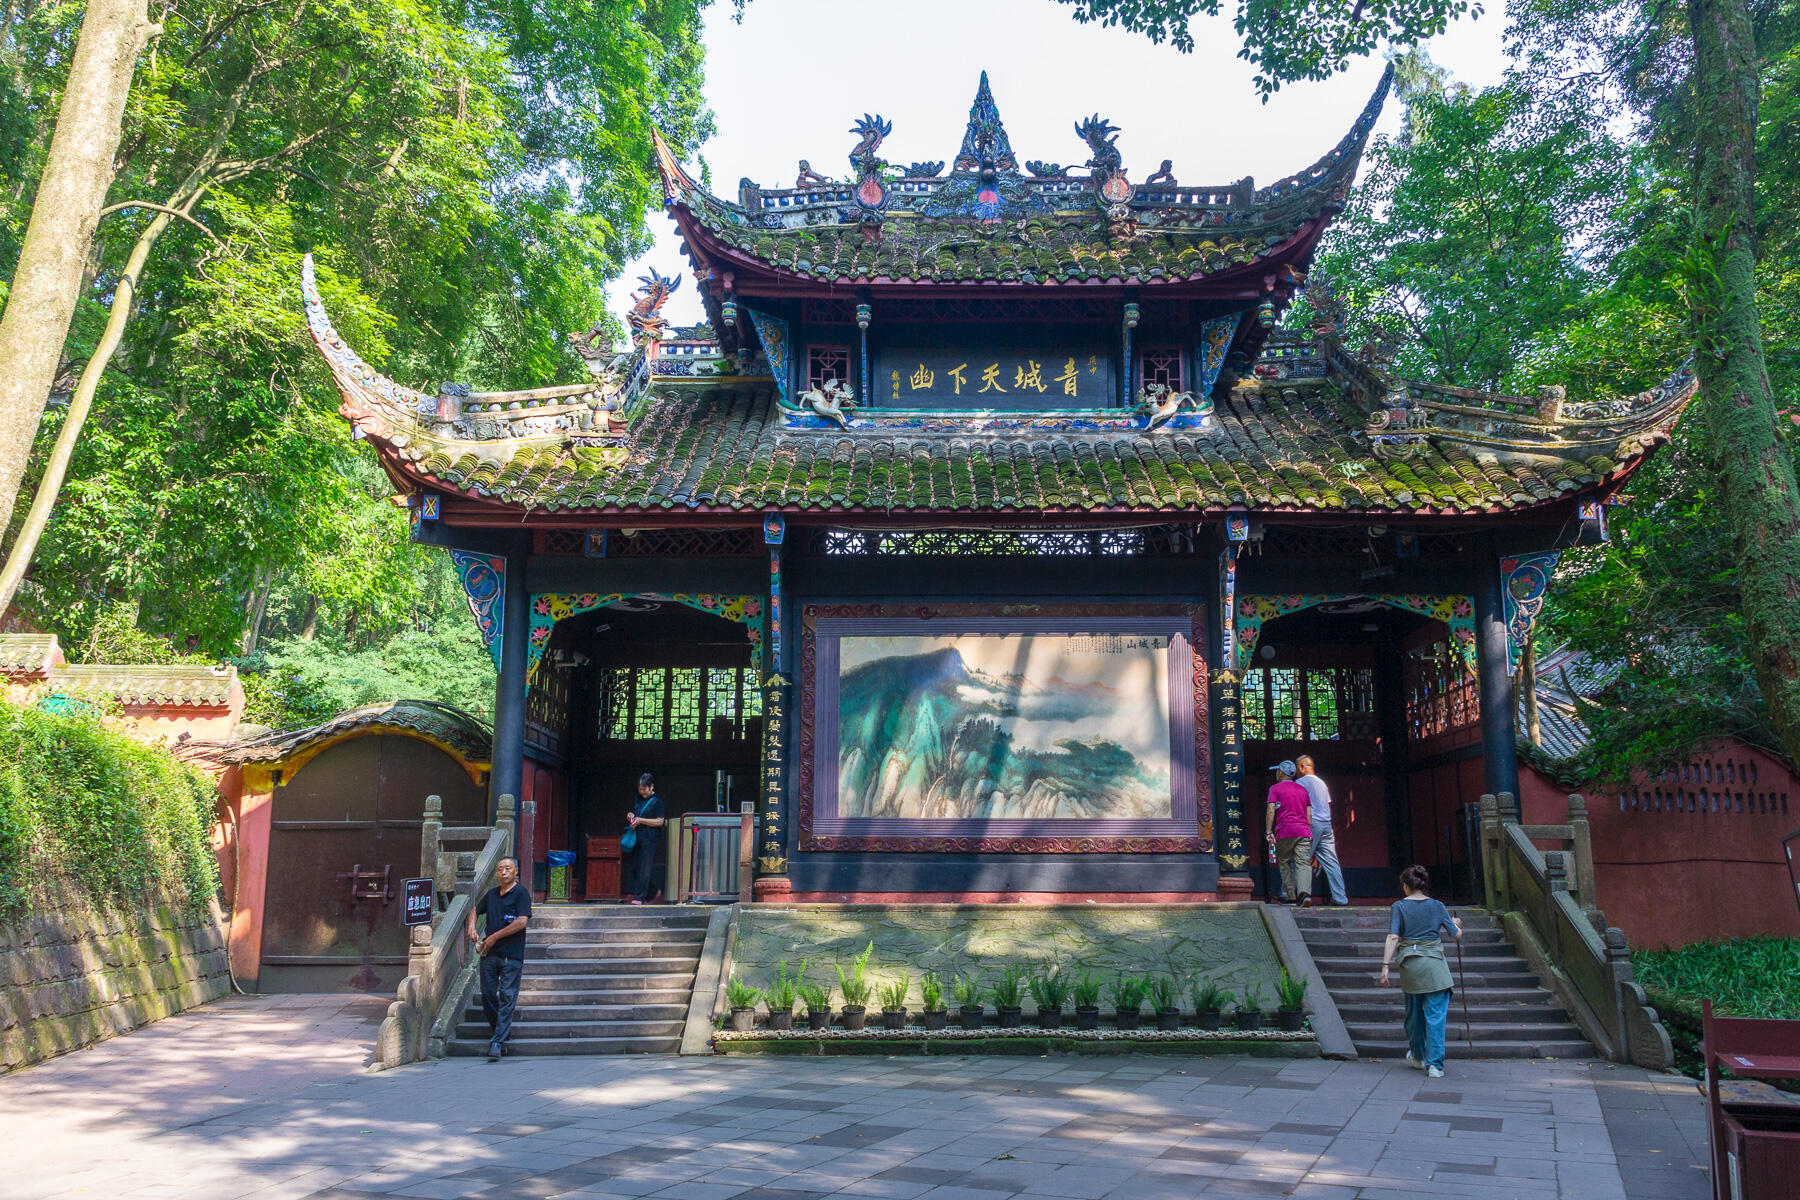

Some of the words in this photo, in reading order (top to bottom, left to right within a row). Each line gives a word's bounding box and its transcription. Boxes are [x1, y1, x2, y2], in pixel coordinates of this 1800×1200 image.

[910, 357, 1080, 397] 青城天下幽
[1126, 638, 1161, 650] 青城山
